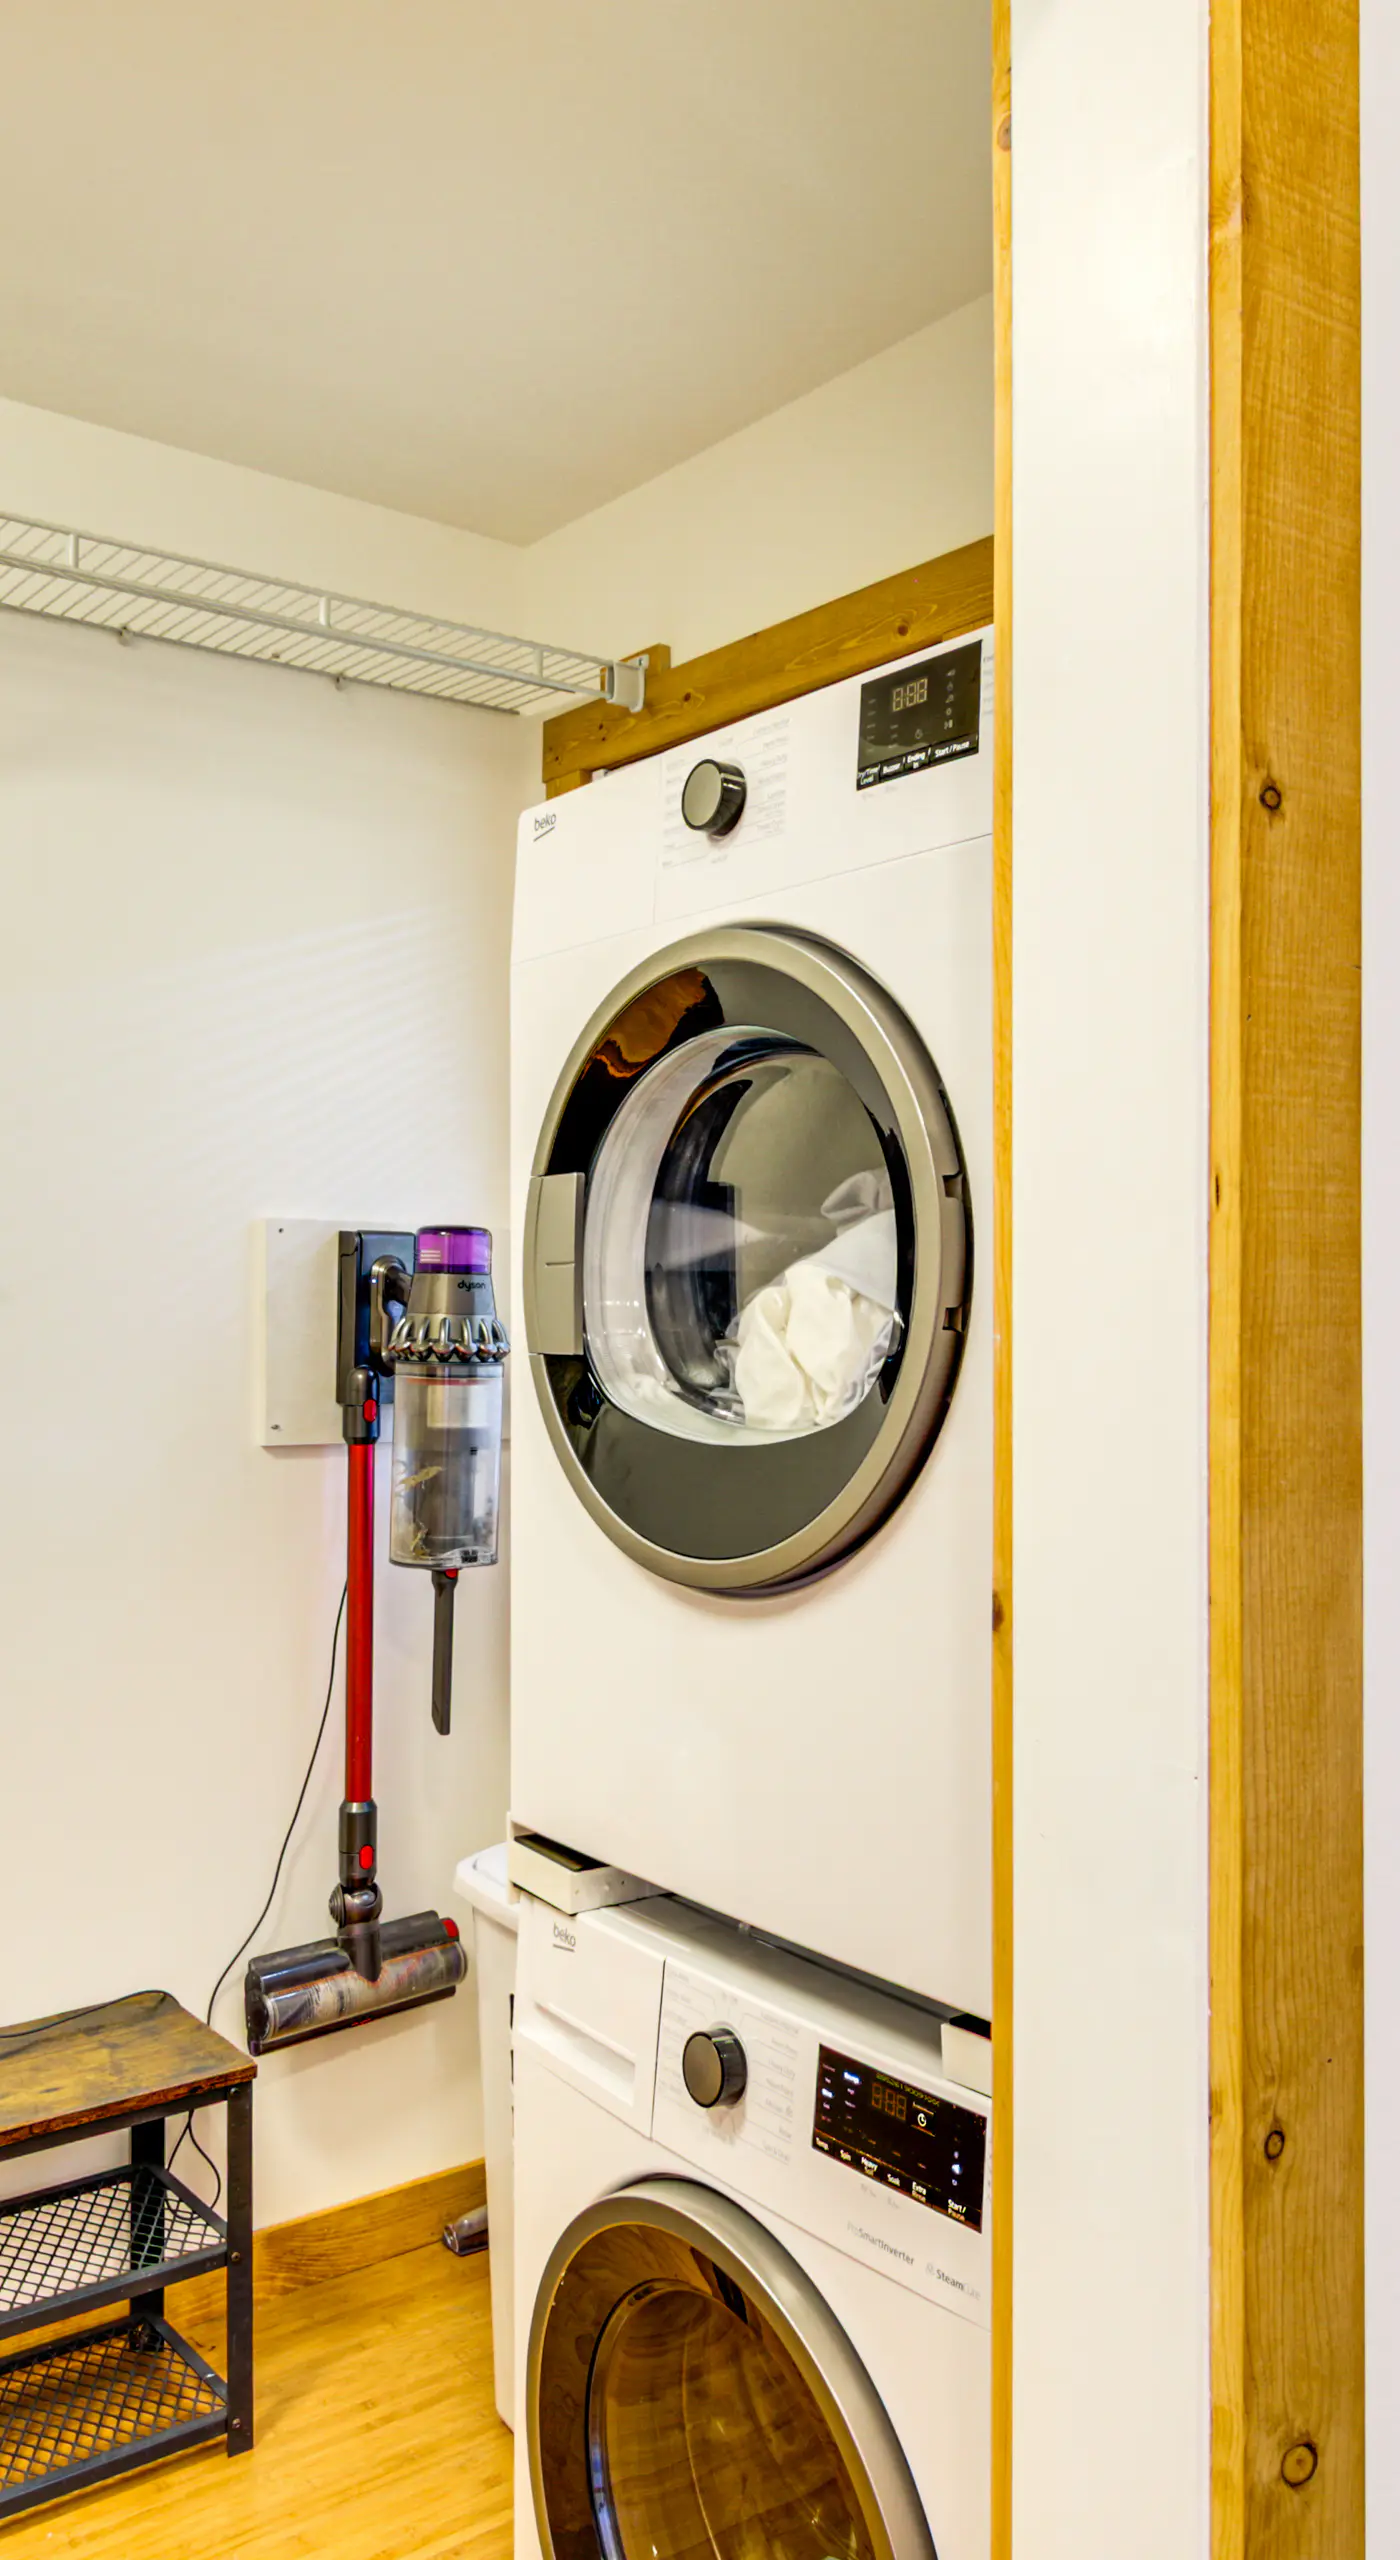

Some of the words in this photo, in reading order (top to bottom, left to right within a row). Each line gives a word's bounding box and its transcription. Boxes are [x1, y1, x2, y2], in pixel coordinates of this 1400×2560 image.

[534, 812, 557, 831] beko
[457, 1279, 486, 1293] dyson
[553, 1919, 576, 1947] beko
[911, 2181, 927, 2196] Extra
